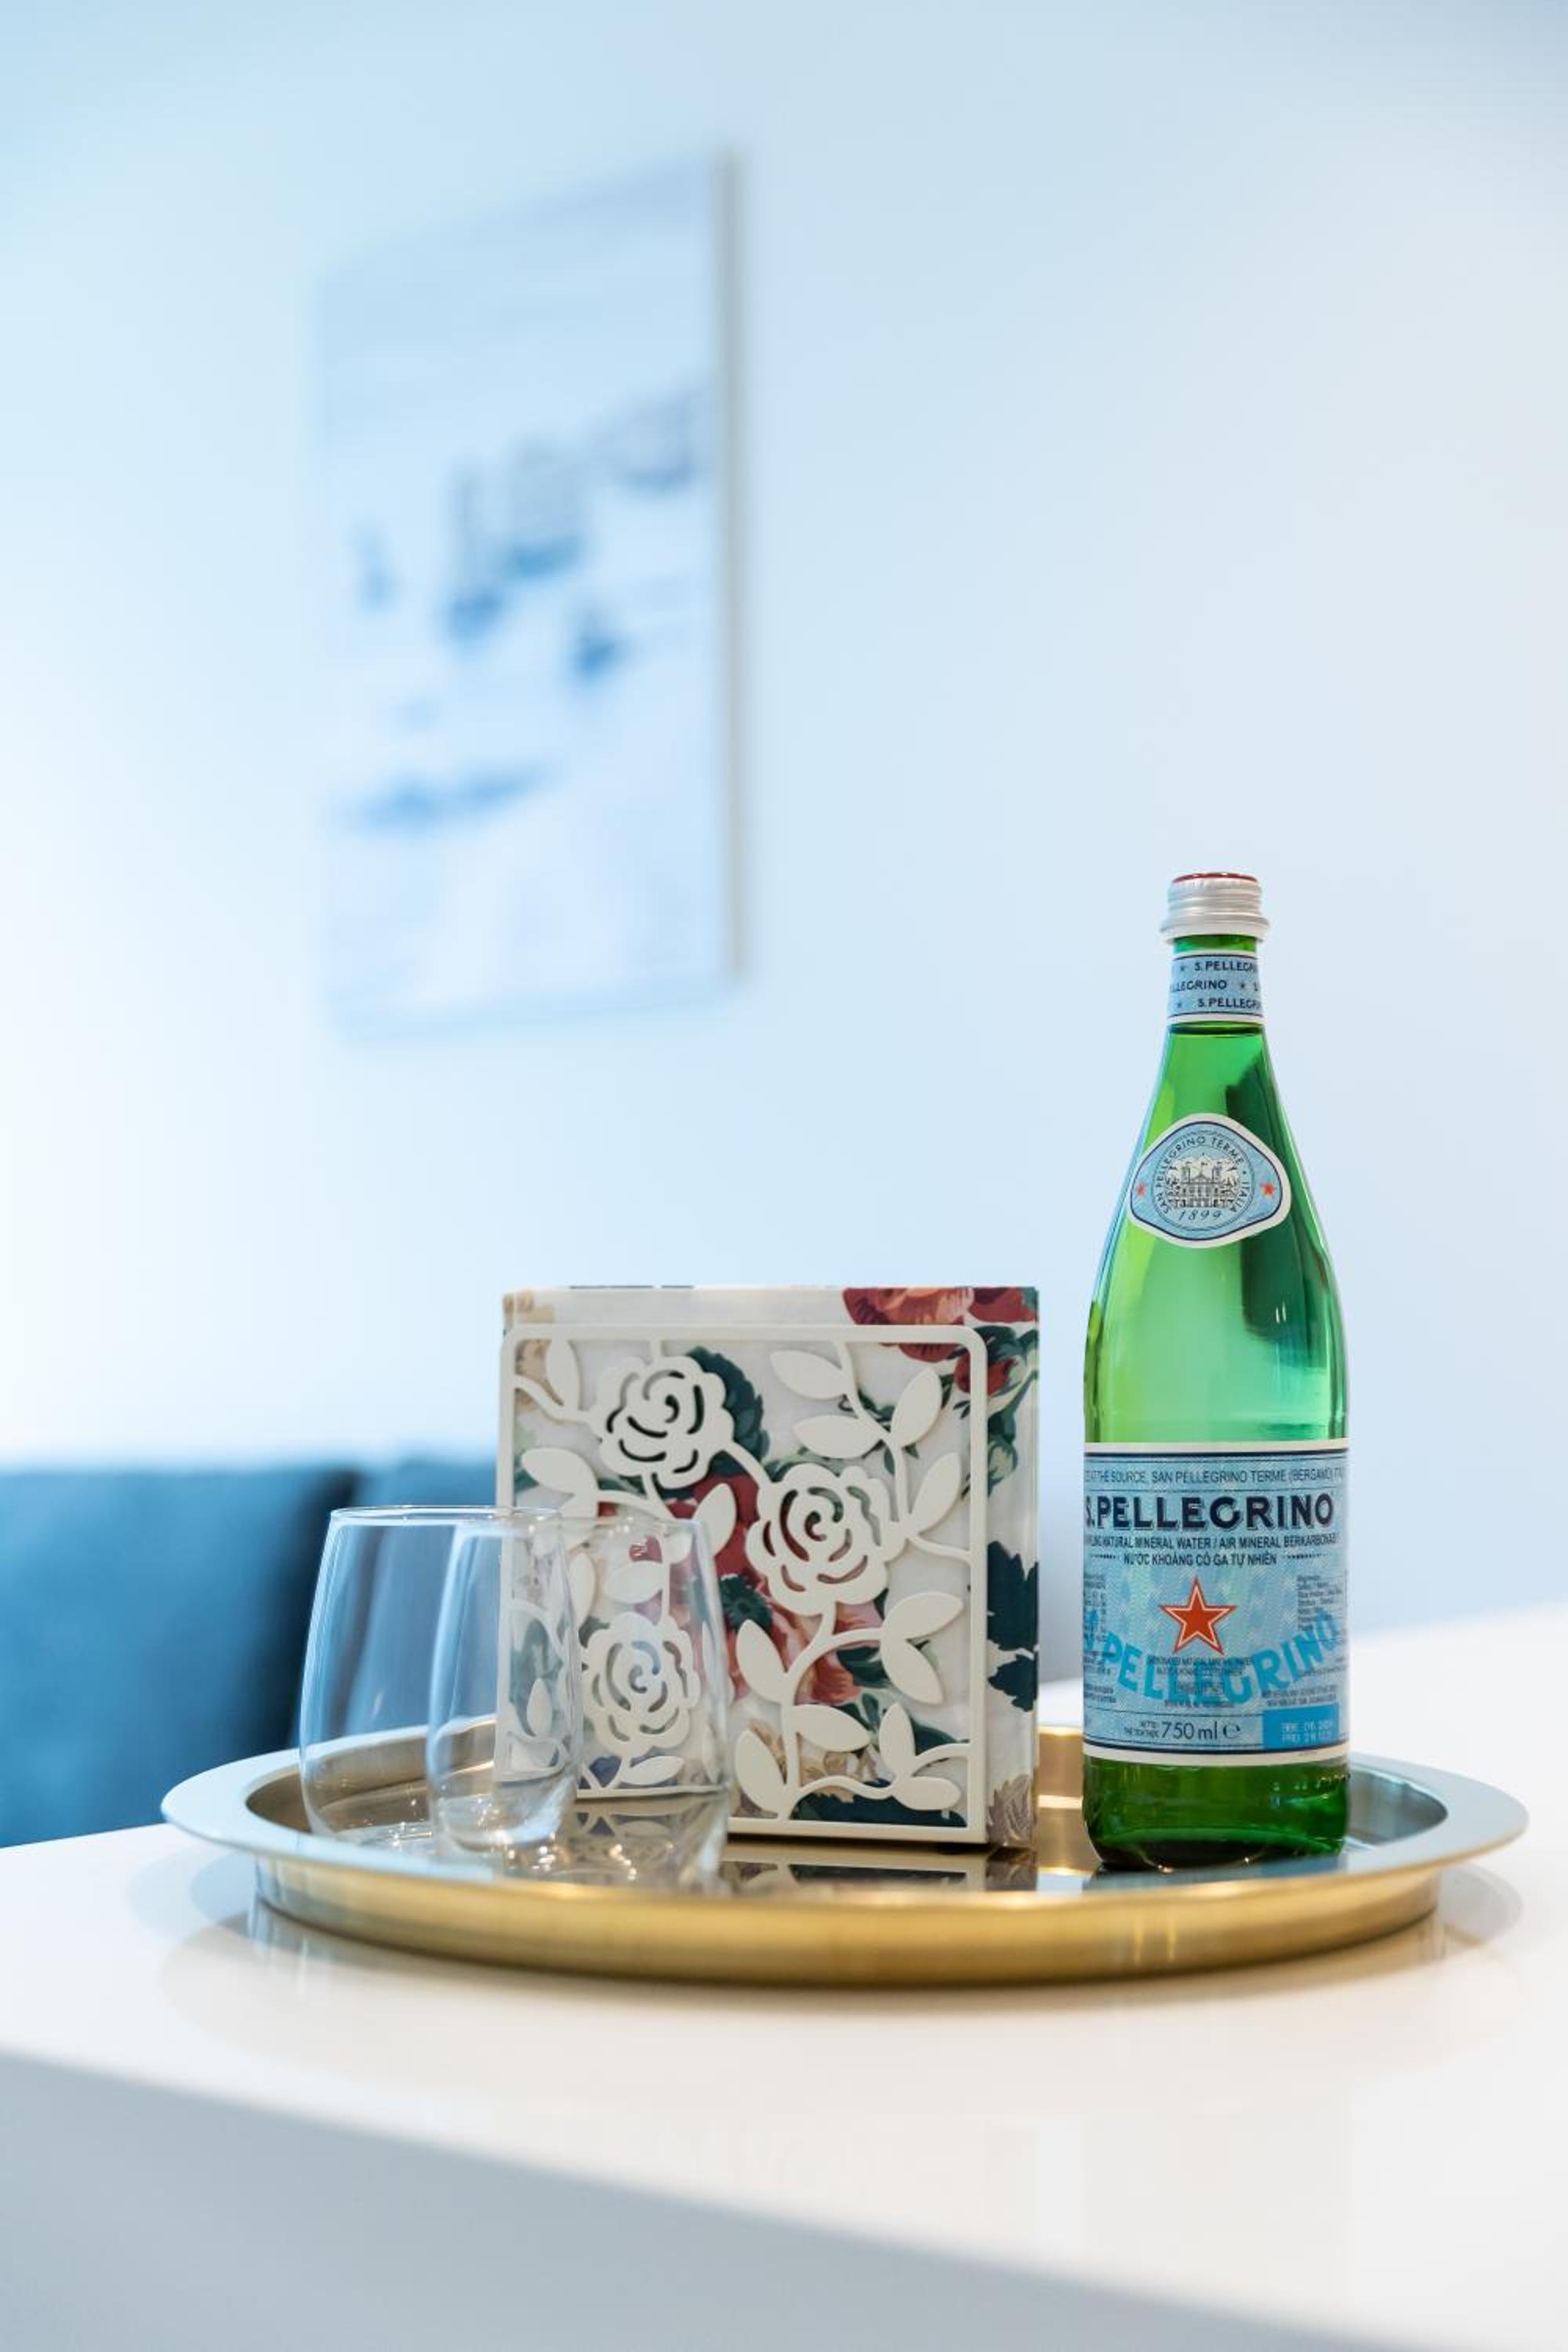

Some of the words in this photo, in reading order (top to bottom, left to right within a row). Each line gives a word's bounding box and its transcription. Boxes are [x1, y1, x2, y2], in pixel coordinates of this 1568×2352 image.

[1211, 1137, 1243, 1165] TERME
[1152, 1471, 1173, 1483] SAN
[1176, 1471, 1247, 1484] PELLEGRINO
[1250, 1470, 1286, 1483] TERME
[1134, 1537, 1174, 1549] MINERAL
[1177, 1537, 1211, 1550] WATER
[1219, 1537, 1236, 1549] AIR
[1239, 1536, 1281, 1549] MINERAL
